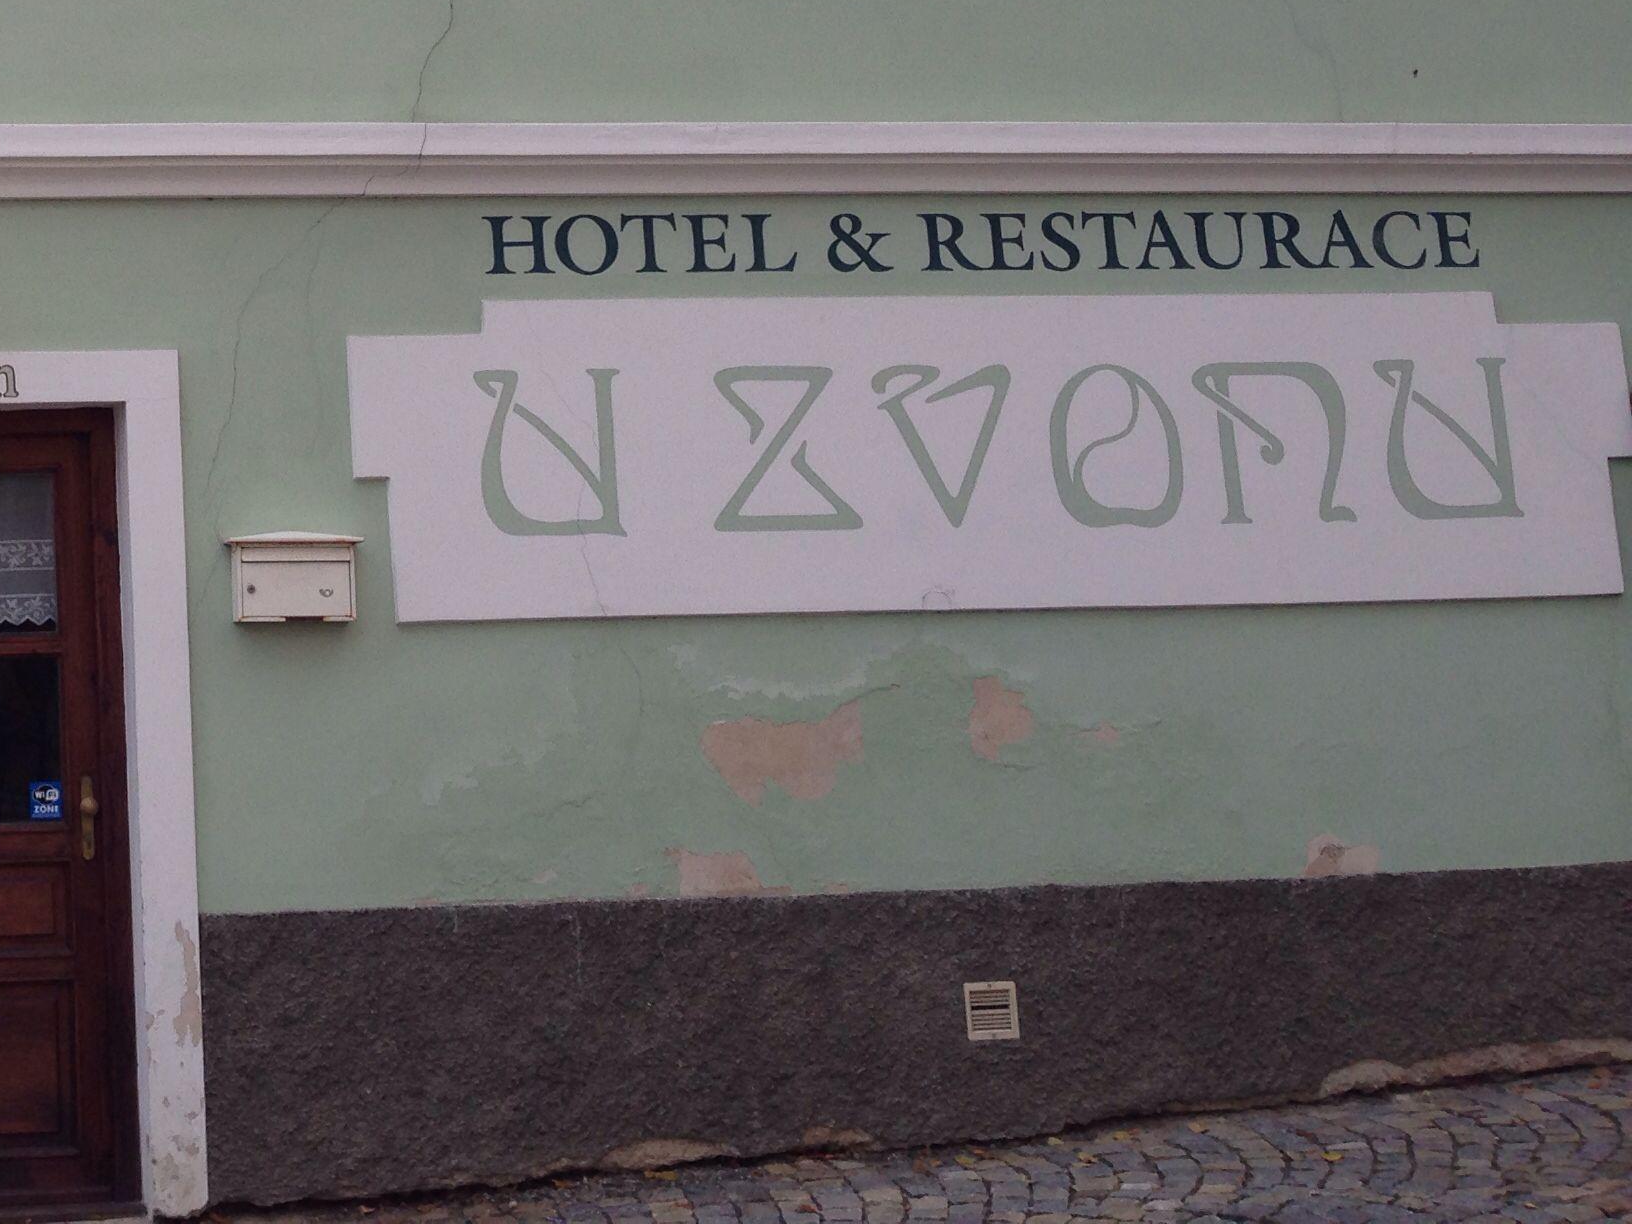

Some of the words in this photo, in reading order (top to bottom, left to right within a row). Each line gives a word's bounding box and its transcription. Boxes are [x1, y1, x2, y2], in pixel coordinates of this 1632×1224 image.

[481, 212, 798, 275] HOTEL
[827, 212, 894, 273] &
[915, 208, 1481, 272] RESTAURACE
